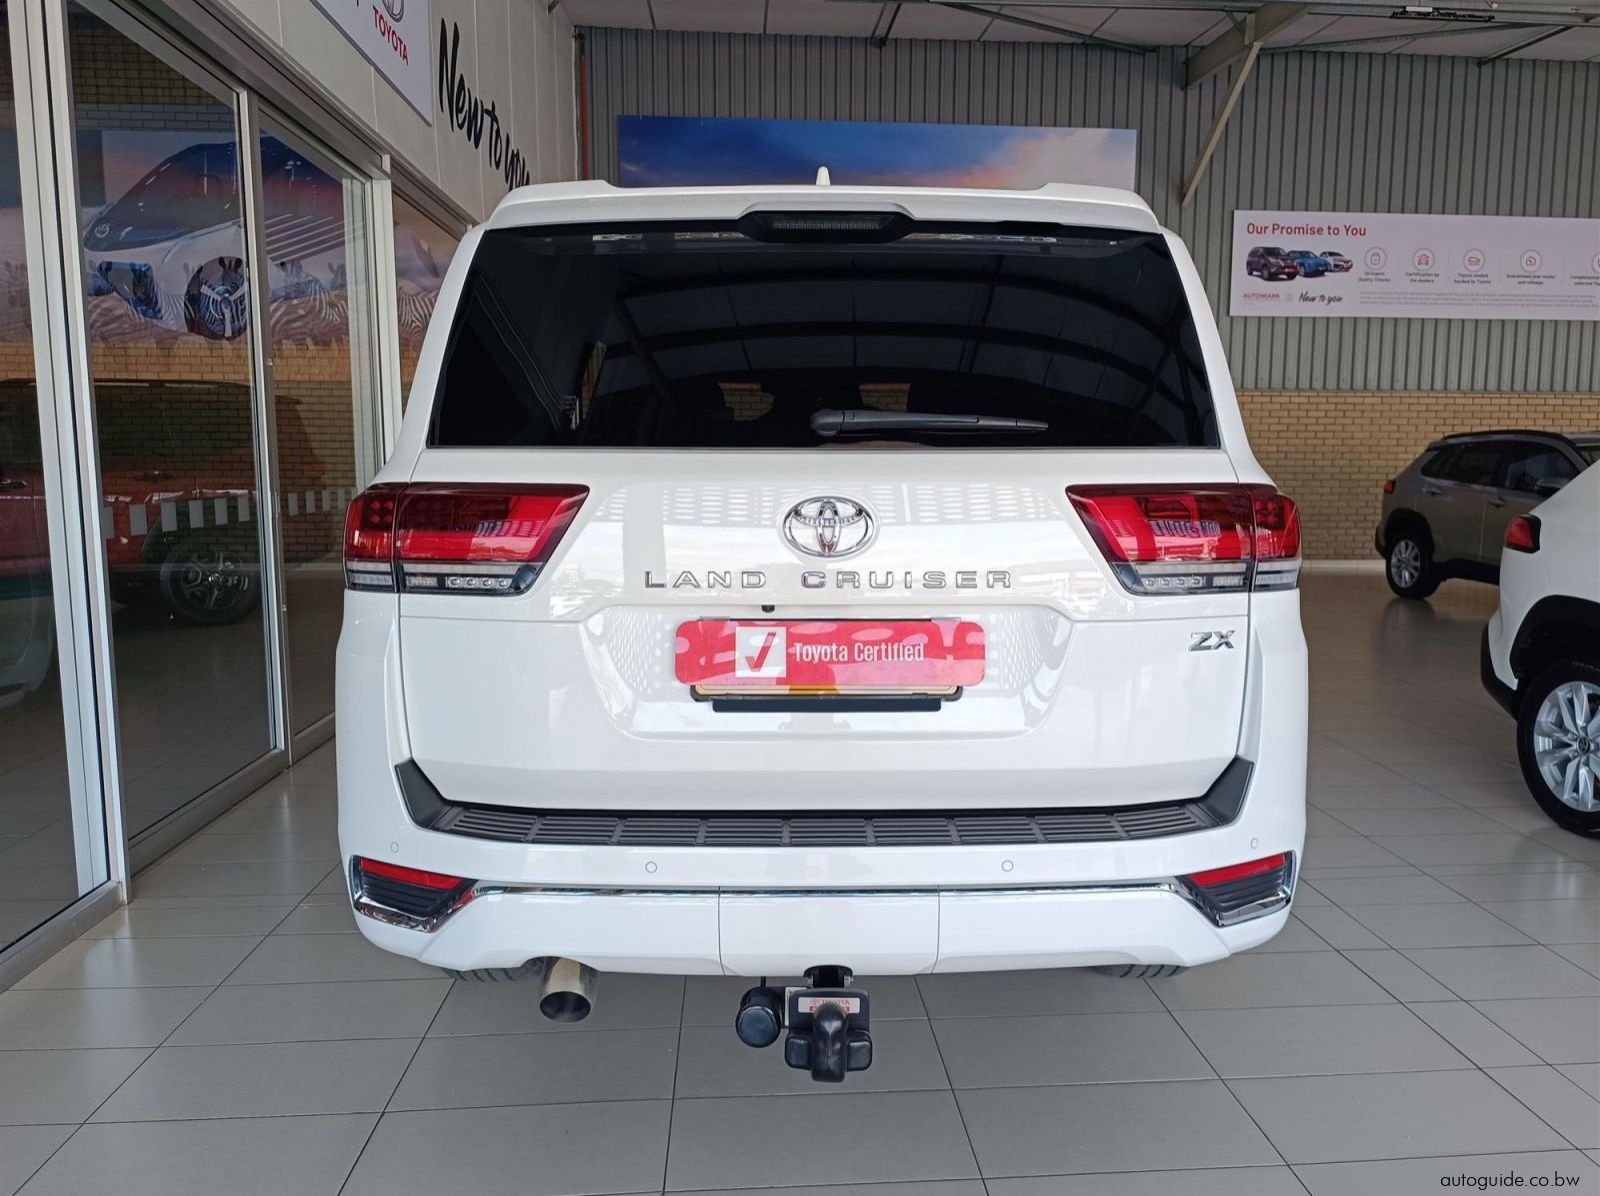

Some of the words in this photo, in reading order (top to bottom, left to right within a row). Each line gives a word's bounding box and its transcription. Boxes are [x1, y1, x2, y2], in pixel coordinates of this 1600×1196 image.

[373, 5, 409, 66] TOYOTA
[439, 17, 484, 150] New
[484, 101, 502, 170] to
[1247, 222, 1269, 235] Our
[1271, 223, 1324, 236] Promise
[1328, 225, 1340, 236] to
[1343, 225, 1367, 237] You
[1299, 291, 1317, 302] New
[644, 570, 767, 589] LAND
[800, 570, 1012, 589] CRUISER
[1188, 629, 1235, 652] ZX
[793, 641, 849, 664] Toyota
[853, 641, 925, 662] Certified
